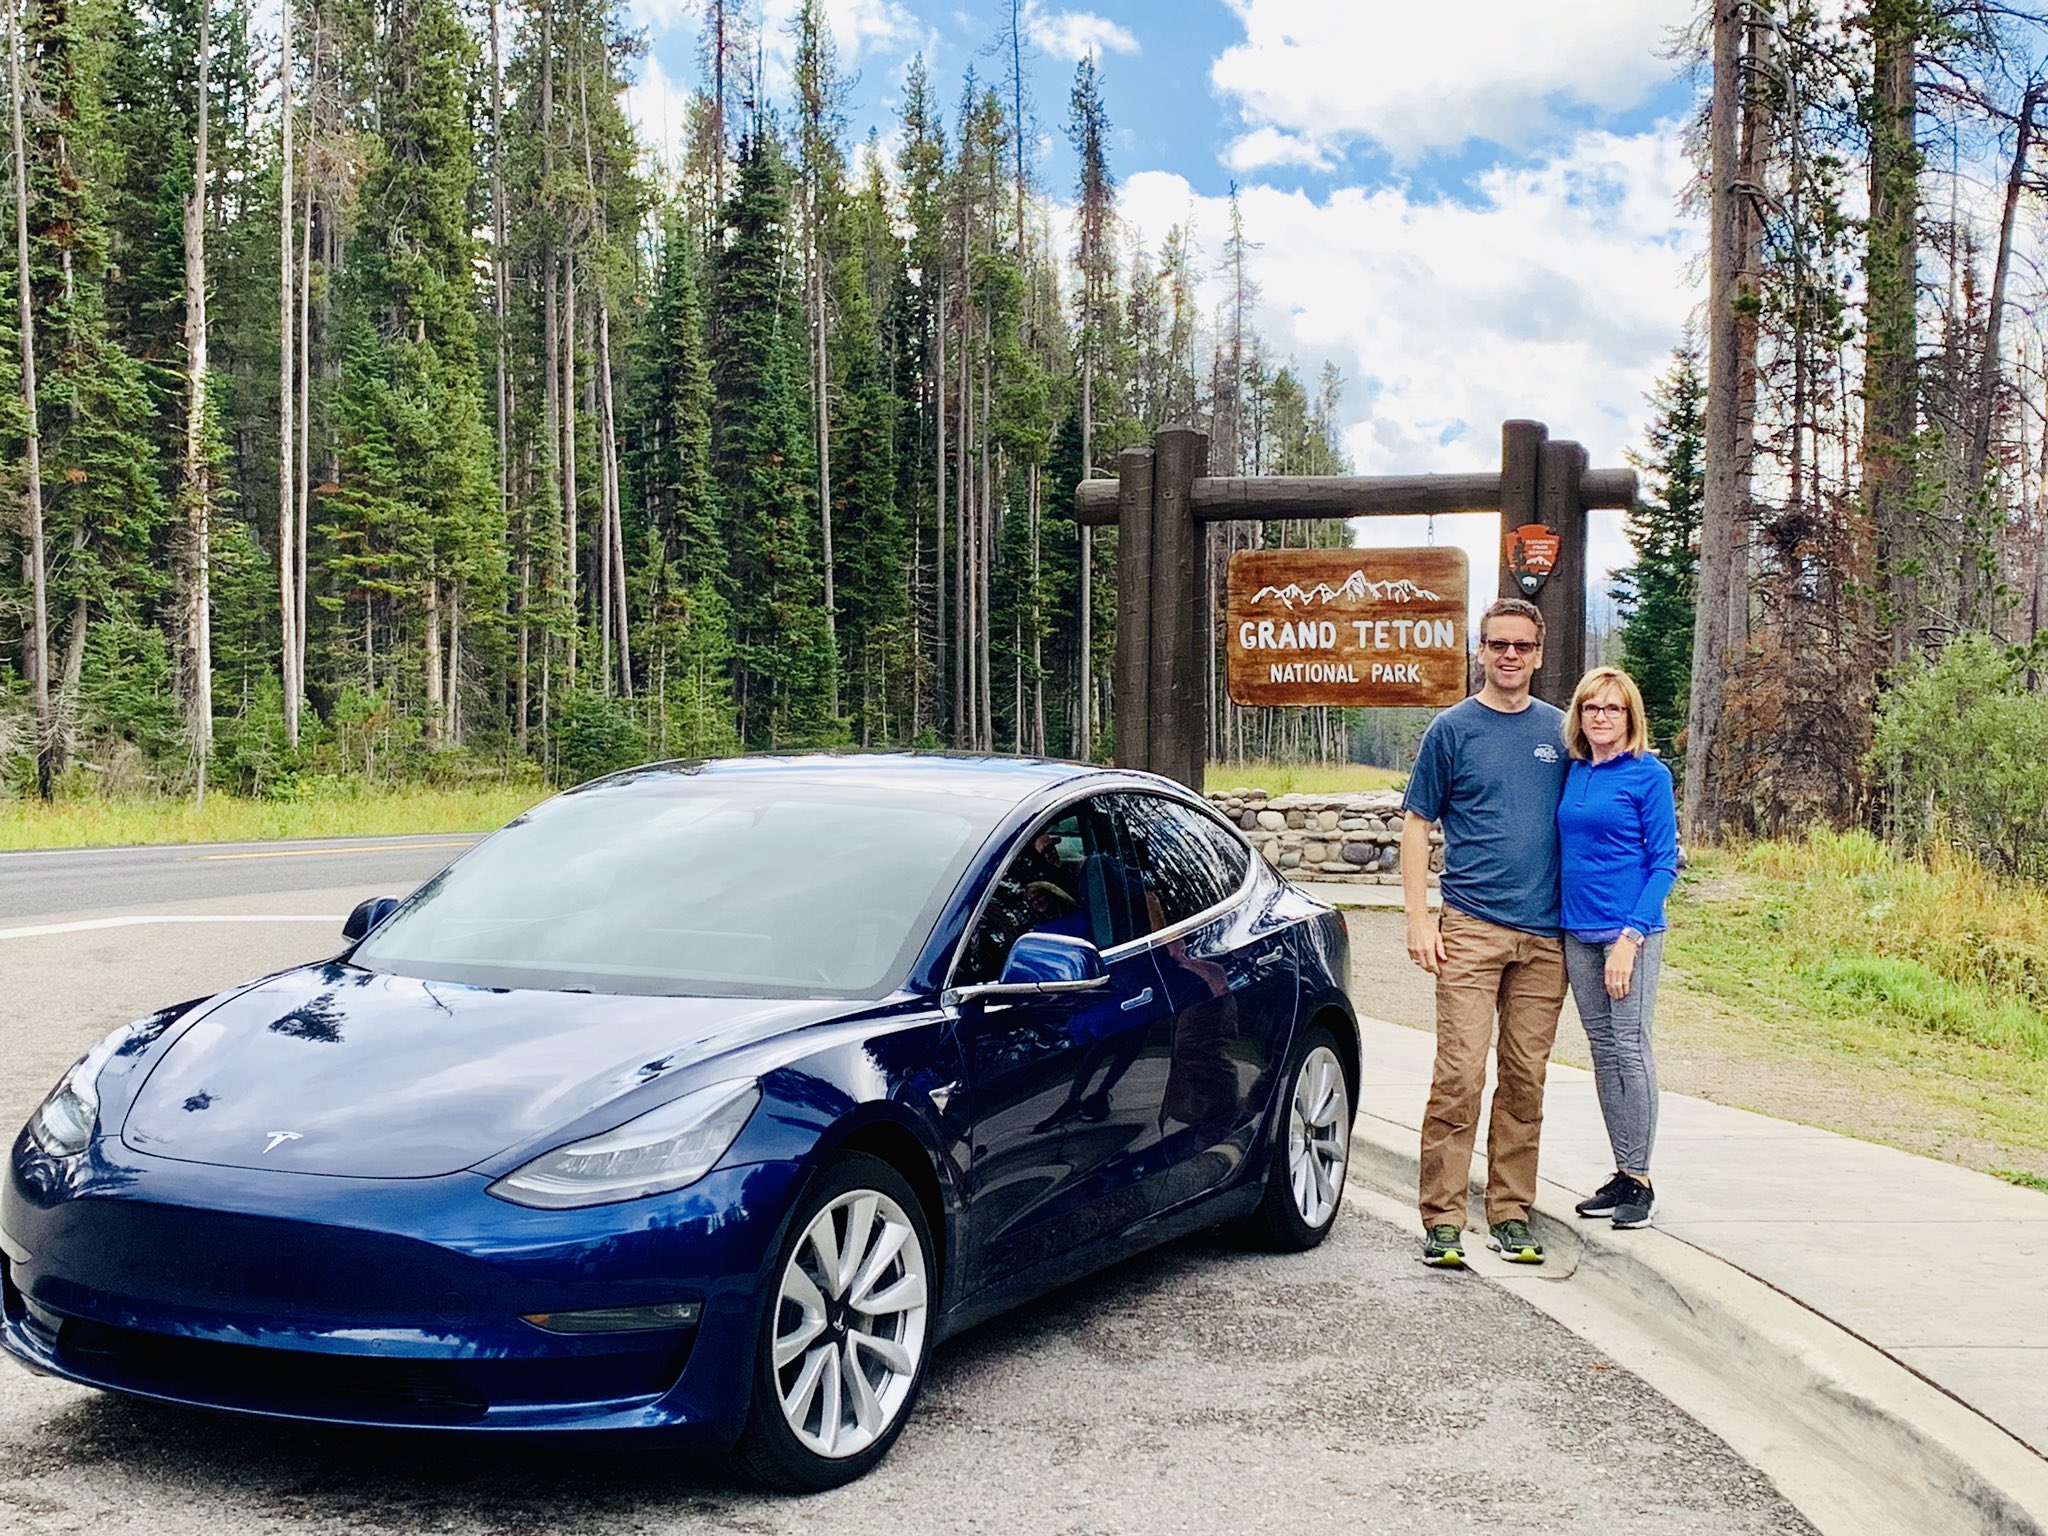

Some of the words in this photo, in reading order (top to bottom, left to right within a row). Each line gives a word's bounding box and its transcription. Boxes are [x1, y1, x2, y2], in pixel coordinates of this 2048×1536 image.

[1240, 621, 1336, 649] GRAND
[1352, 620, 1454, 649] TETON
[1271, 663, 1359, 684] NATIONAL
[1372, 663, 1420, 684] PARK
